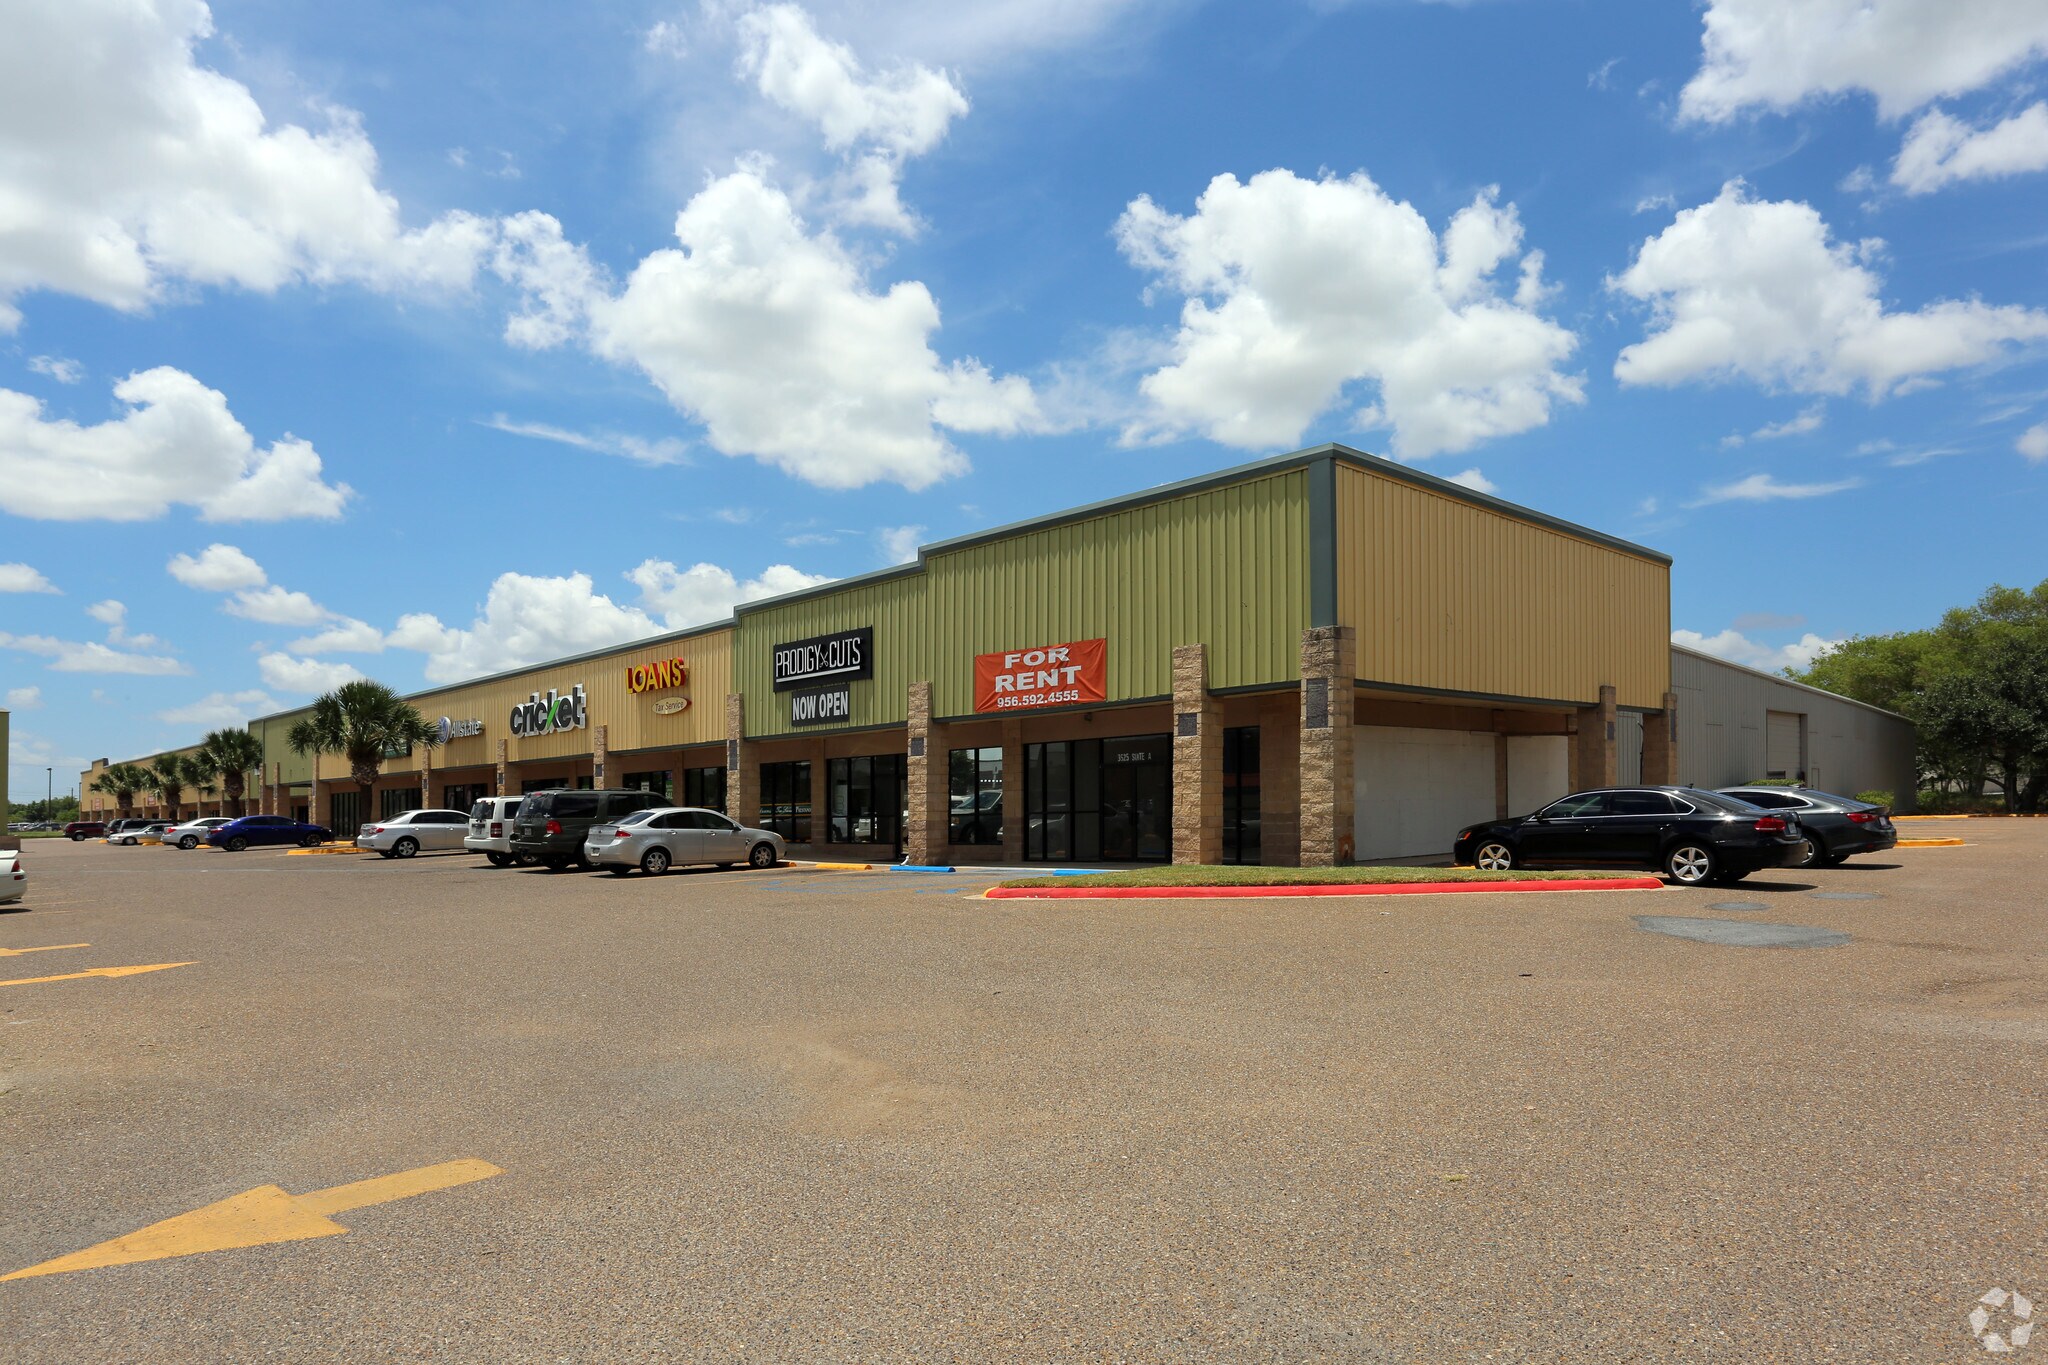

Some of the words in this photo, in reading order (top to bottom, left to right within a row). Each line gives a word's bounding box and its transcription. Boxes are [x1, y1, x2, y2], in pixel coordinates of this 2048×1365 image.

[776, 644, 821, 677] PRODIGY
[829, 637, 861, 668] CUTS
[1004, 647, 1070, 669] FOR
[625, 658, 684, 694] LOANS
[995, 665, 1082, 693] RENT
[510, 685, 585, 736] cricket
[655, 703, 664, 712] Tax
[664, 701, 684, 711] Service
[792, 695, 816, 721] NOW
[819, 691, 849, 718] OPEN
[997, 689, 1079, 708] 956.592.4555
[450, 720, 480, 738] Allstate
[1131, 752, 1145, 761] SUITE
[1147, 752, 1152, 760] A
